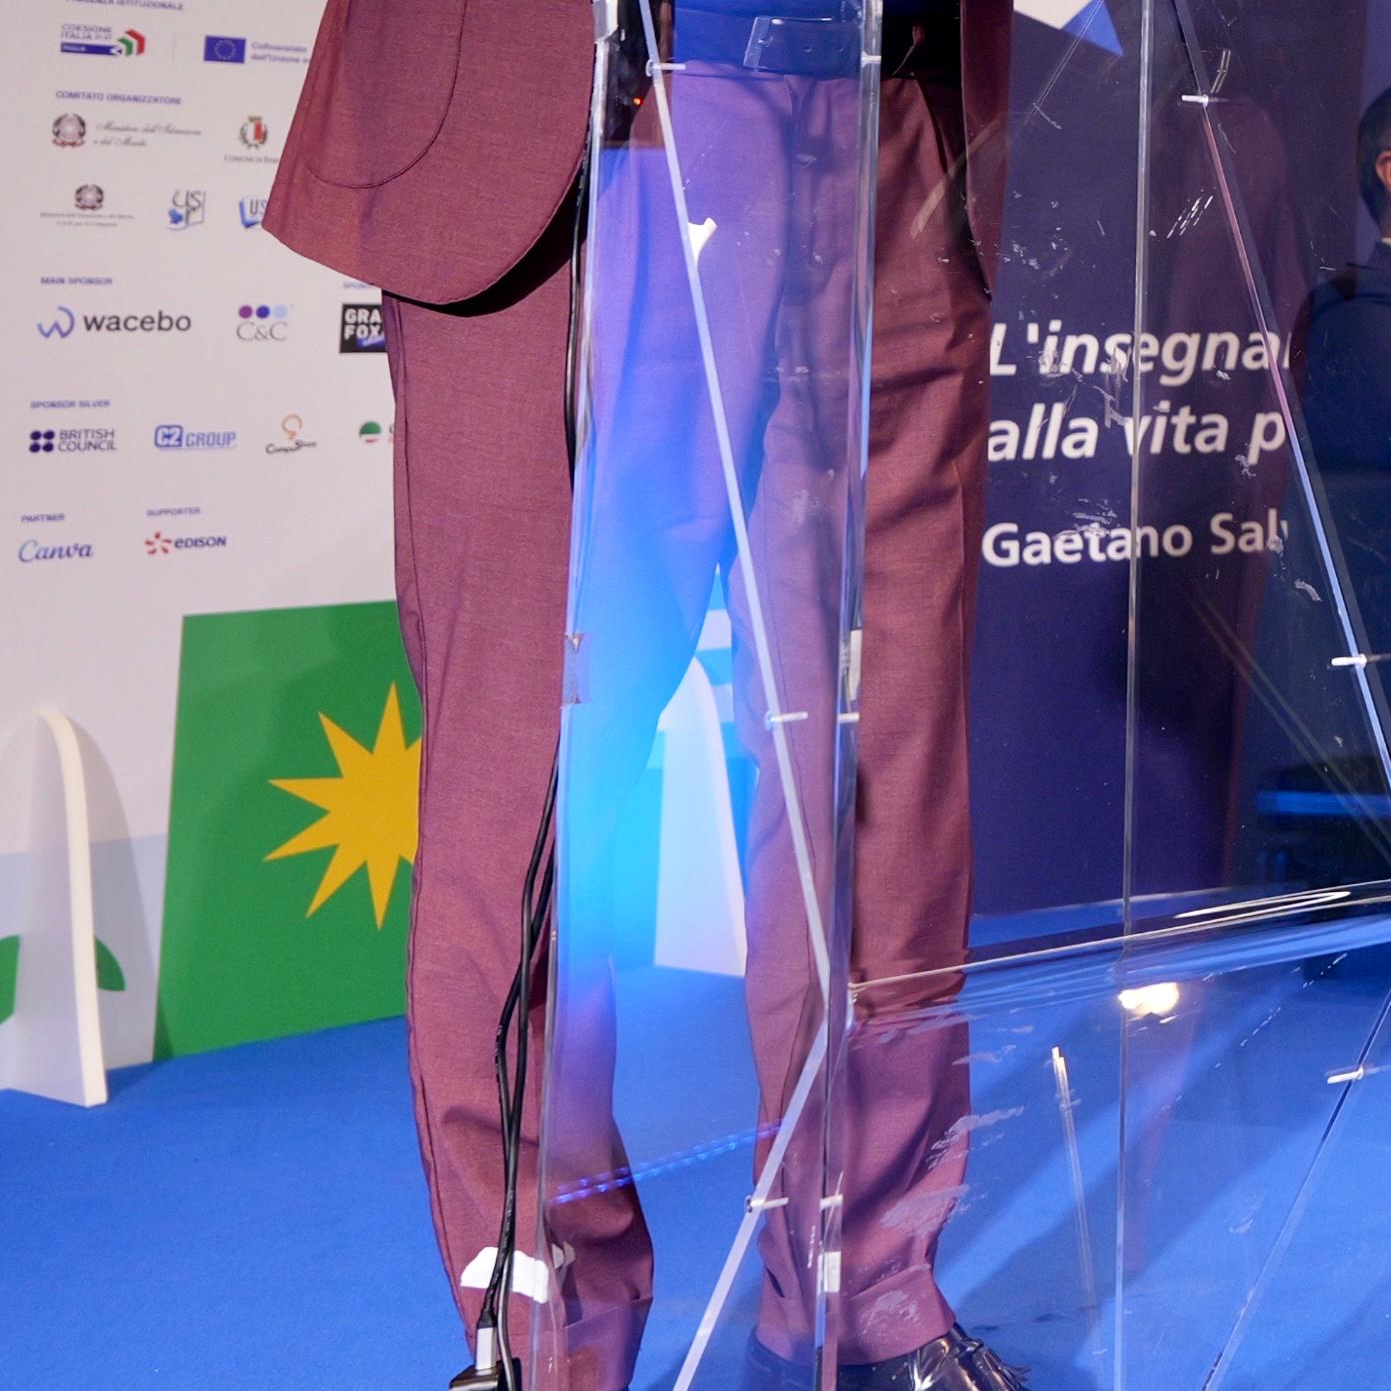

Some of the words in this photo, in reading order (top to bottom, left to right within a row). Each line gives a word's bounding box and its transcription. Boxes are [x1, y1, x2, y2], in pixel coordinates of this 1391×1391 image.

[83, 310, 191, 333] wacebo
[344, 308, 382, 325] GRA
[236, 320, 288, 342] C&C
[59, 429, 115, 440] BRITISH
[185, 431, 236, 448] GROUP
[988, 403, 1098, 462] alla
[1124, 400, 1228, 457] vita
[58, 440, 117, 452] COUNCIL
[18, 539, 94, 563] Canva
[981, 521, 1193, 567] Gaetano
